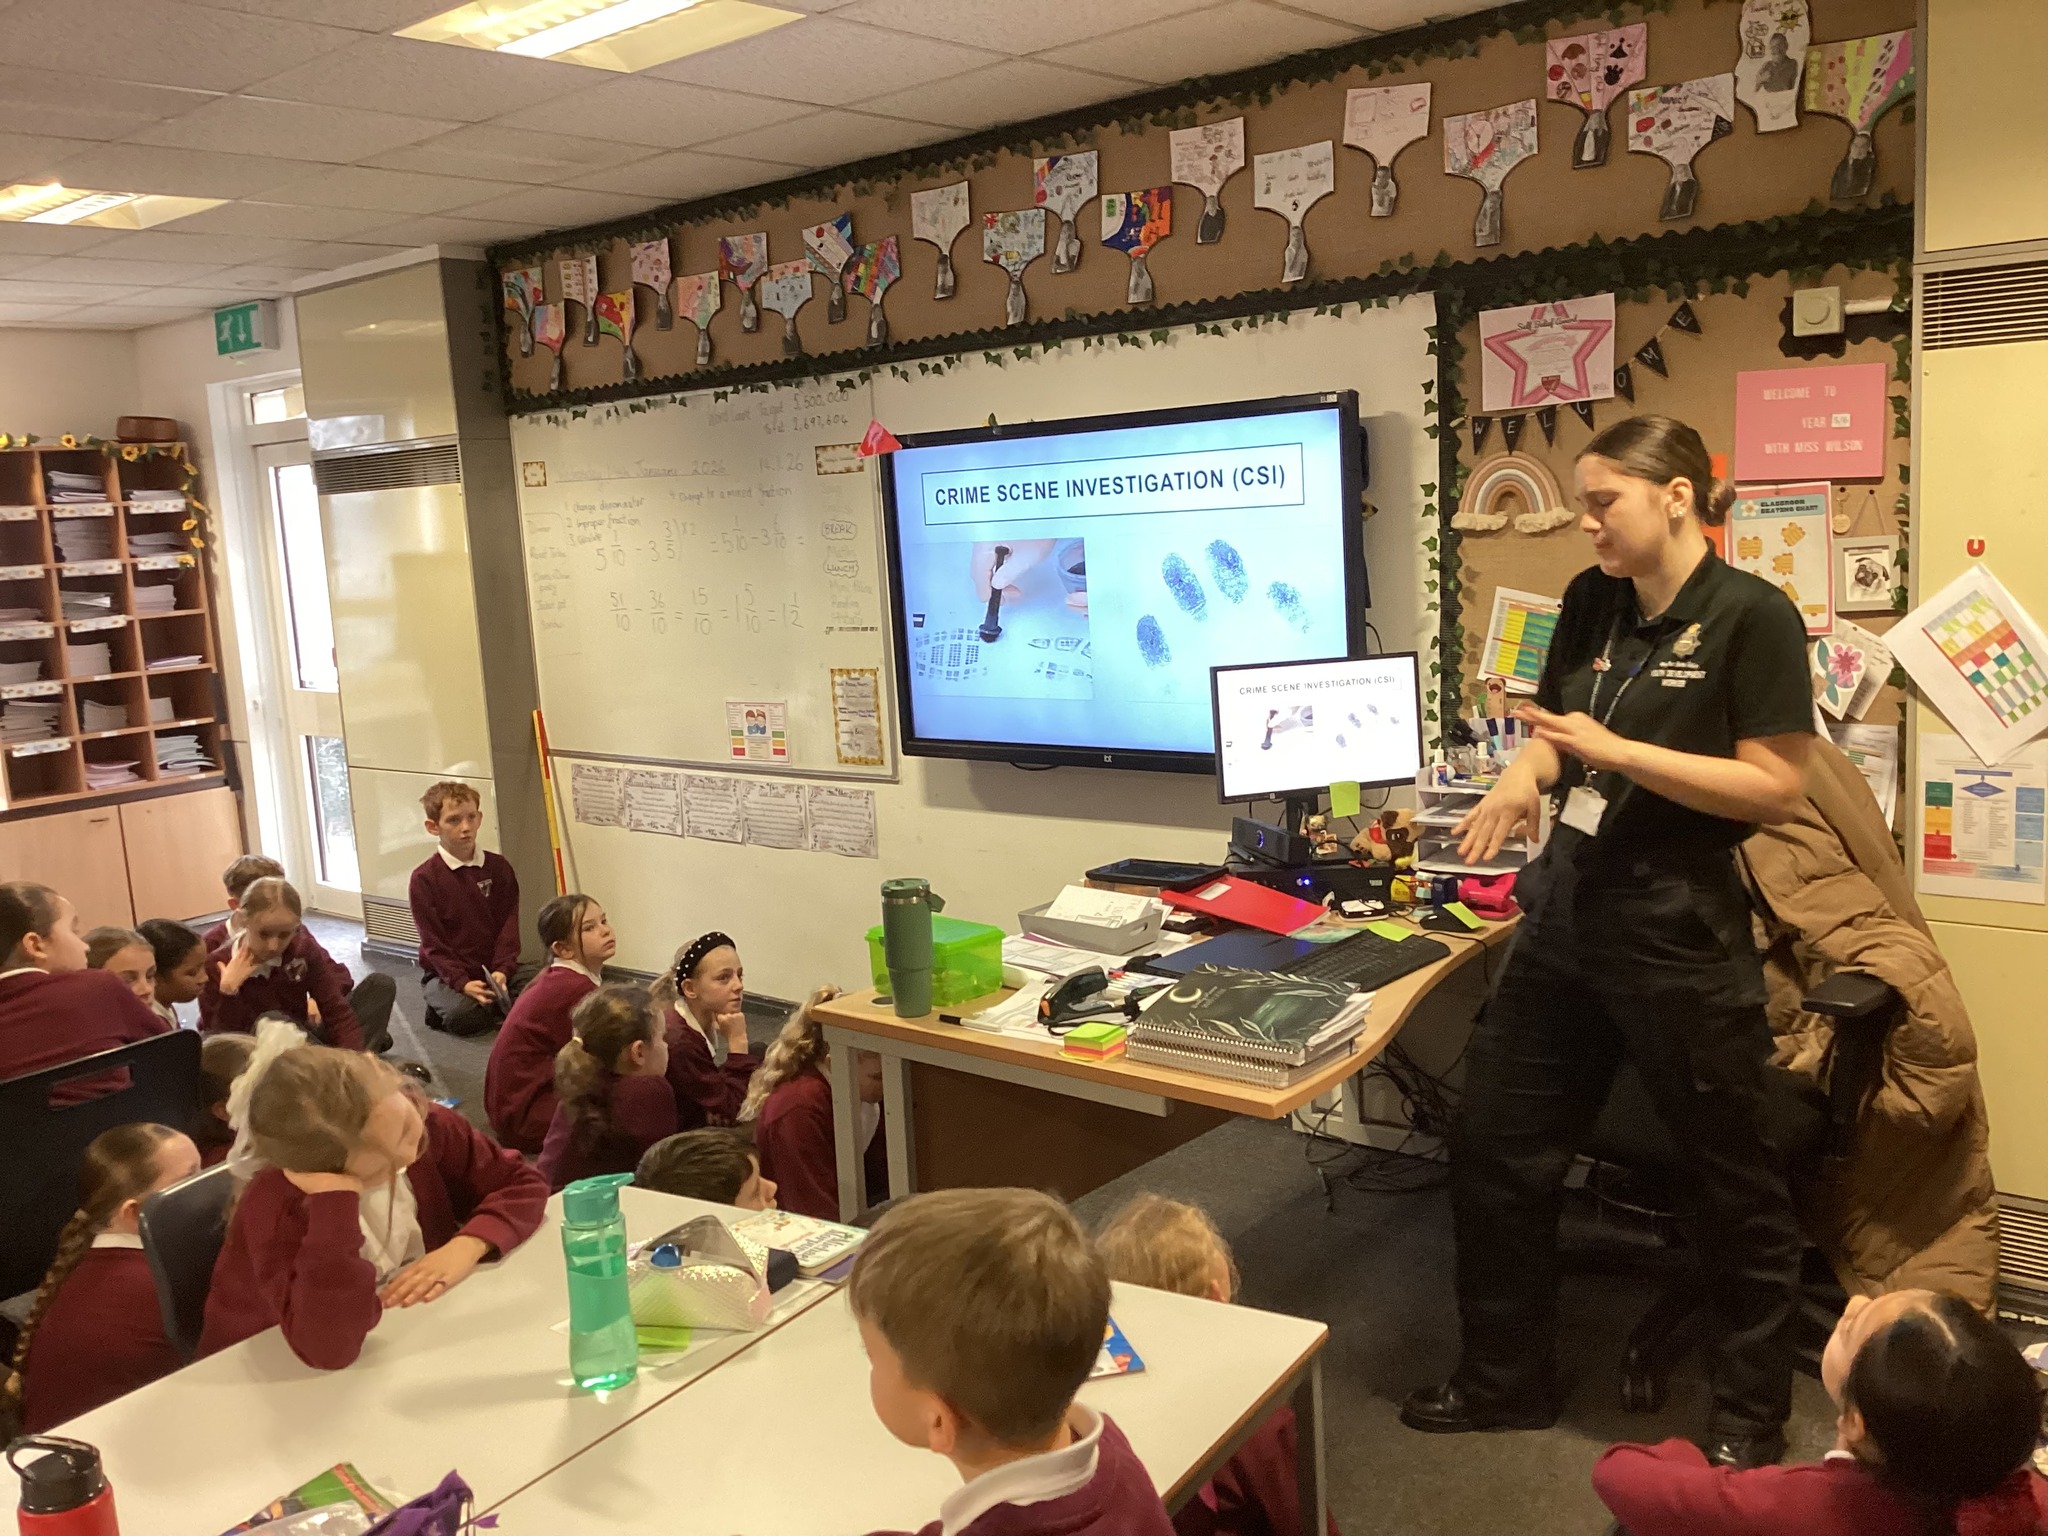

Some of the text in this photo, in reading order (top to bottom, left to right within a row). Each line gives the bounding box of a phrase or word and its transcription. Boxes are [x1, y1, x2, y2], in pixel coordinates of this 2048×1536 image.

[1763, 385, 1837, 400] WELCOME TO
[1801, 416, 1826, 429] YEAR
[1764, 439, 1864, 454] WITH MISS WILSON
[935, 464, 1286, 506] CRIME SCENE INVESTIGATION (CSI)
[1760, 499, 1805, 507] CLASSROOM
[825, 523, 853, 535] BREAK
[827, 563, 855, 573] LUNCH
[1239, 675, 1396, 695] CRIME SCENE INVESTIGATION (CSI)
